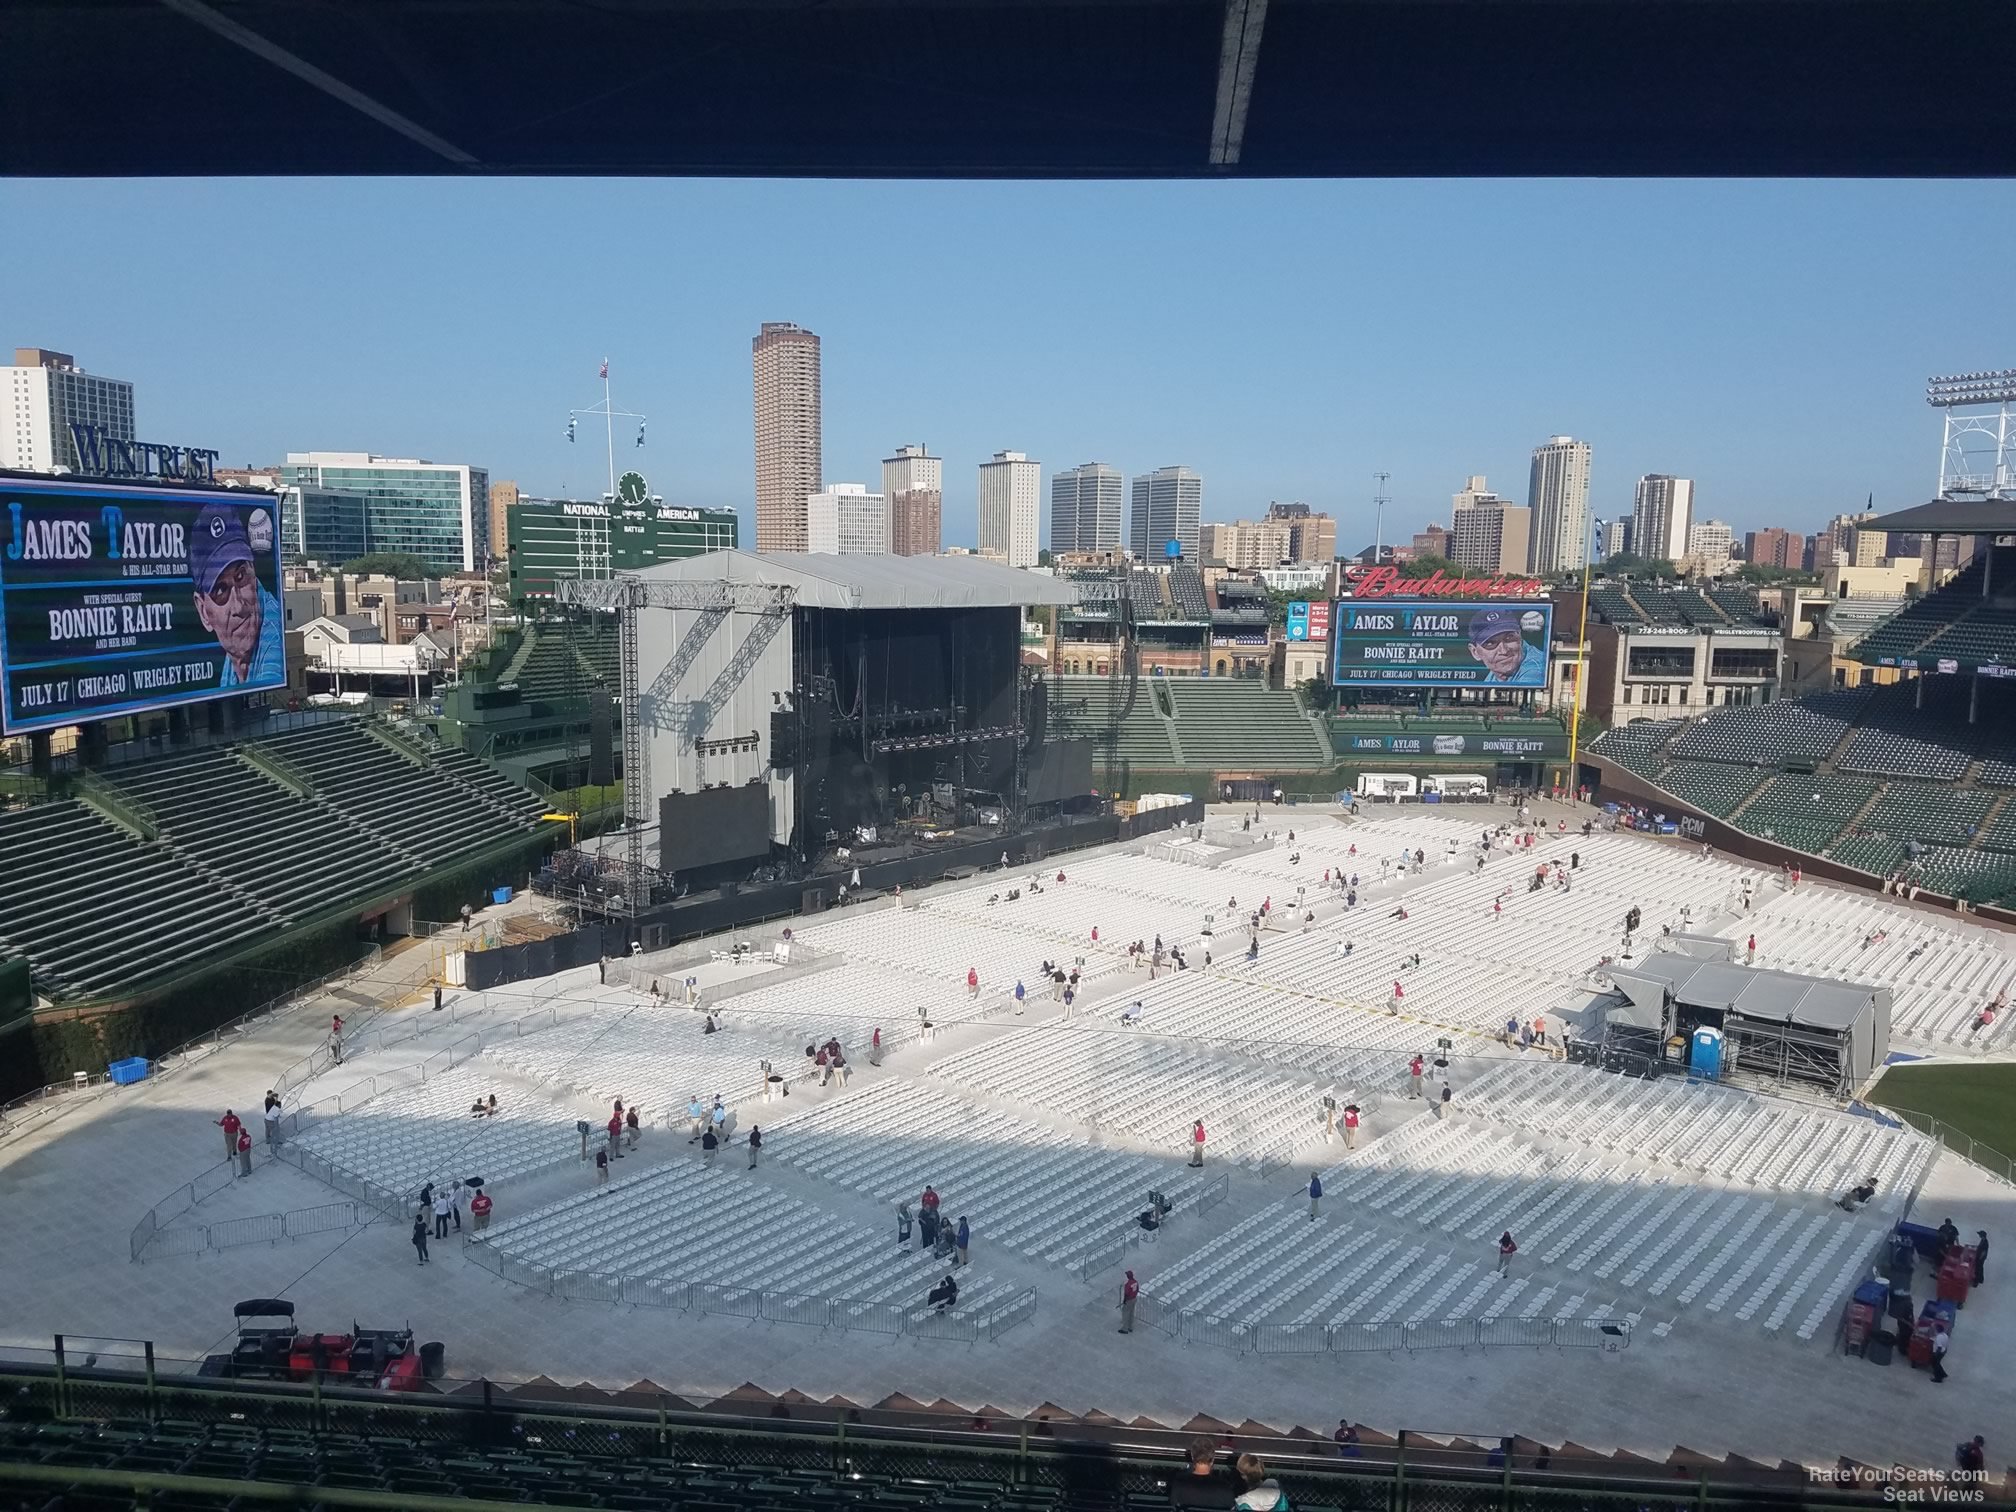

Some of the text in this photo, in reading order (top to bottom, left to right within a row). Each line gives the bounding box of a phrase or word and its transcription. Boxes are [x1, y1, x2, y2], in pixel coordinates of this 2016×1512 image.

[69, 423, 220, 481] WINTRUST
[563, 504, 611, 517] NATIONAL
[657, 509, 700, 520] AMERICAN
[8, 503, 187, 560] JAMES TAYLOR
[122, 564, 188, 576] & HIS ALL-STAR BAND
[1347, 565, 1544, 598] Budweiser
[83, 592, 142, 605] WITH SPECIAL GUEST
[49, 603, 173, 640] BONNIE RAITT
[1346, 609, 1394, 631] JAMES
[1402, 610, 1459, 631] TAYLOR
[95, 636, 137, 649] AND HER BAND
[1364, 647, 1444, 659] BONNIE RAITT
[1349, 670, 1477, 679] JULY 17 CHICAGO WRIGLEY FIELD
[20, 661, 214, 707] JULY 17 CHICAGO WRIGLEY FIELD
[1352, 735, 1382, 749] JAMES
[1386, 735, 1420, 749] TAYLOR
[1483, 741, 1544, 751] BONNIE RAITT
[1681, 815, 1705, 834] PCM
